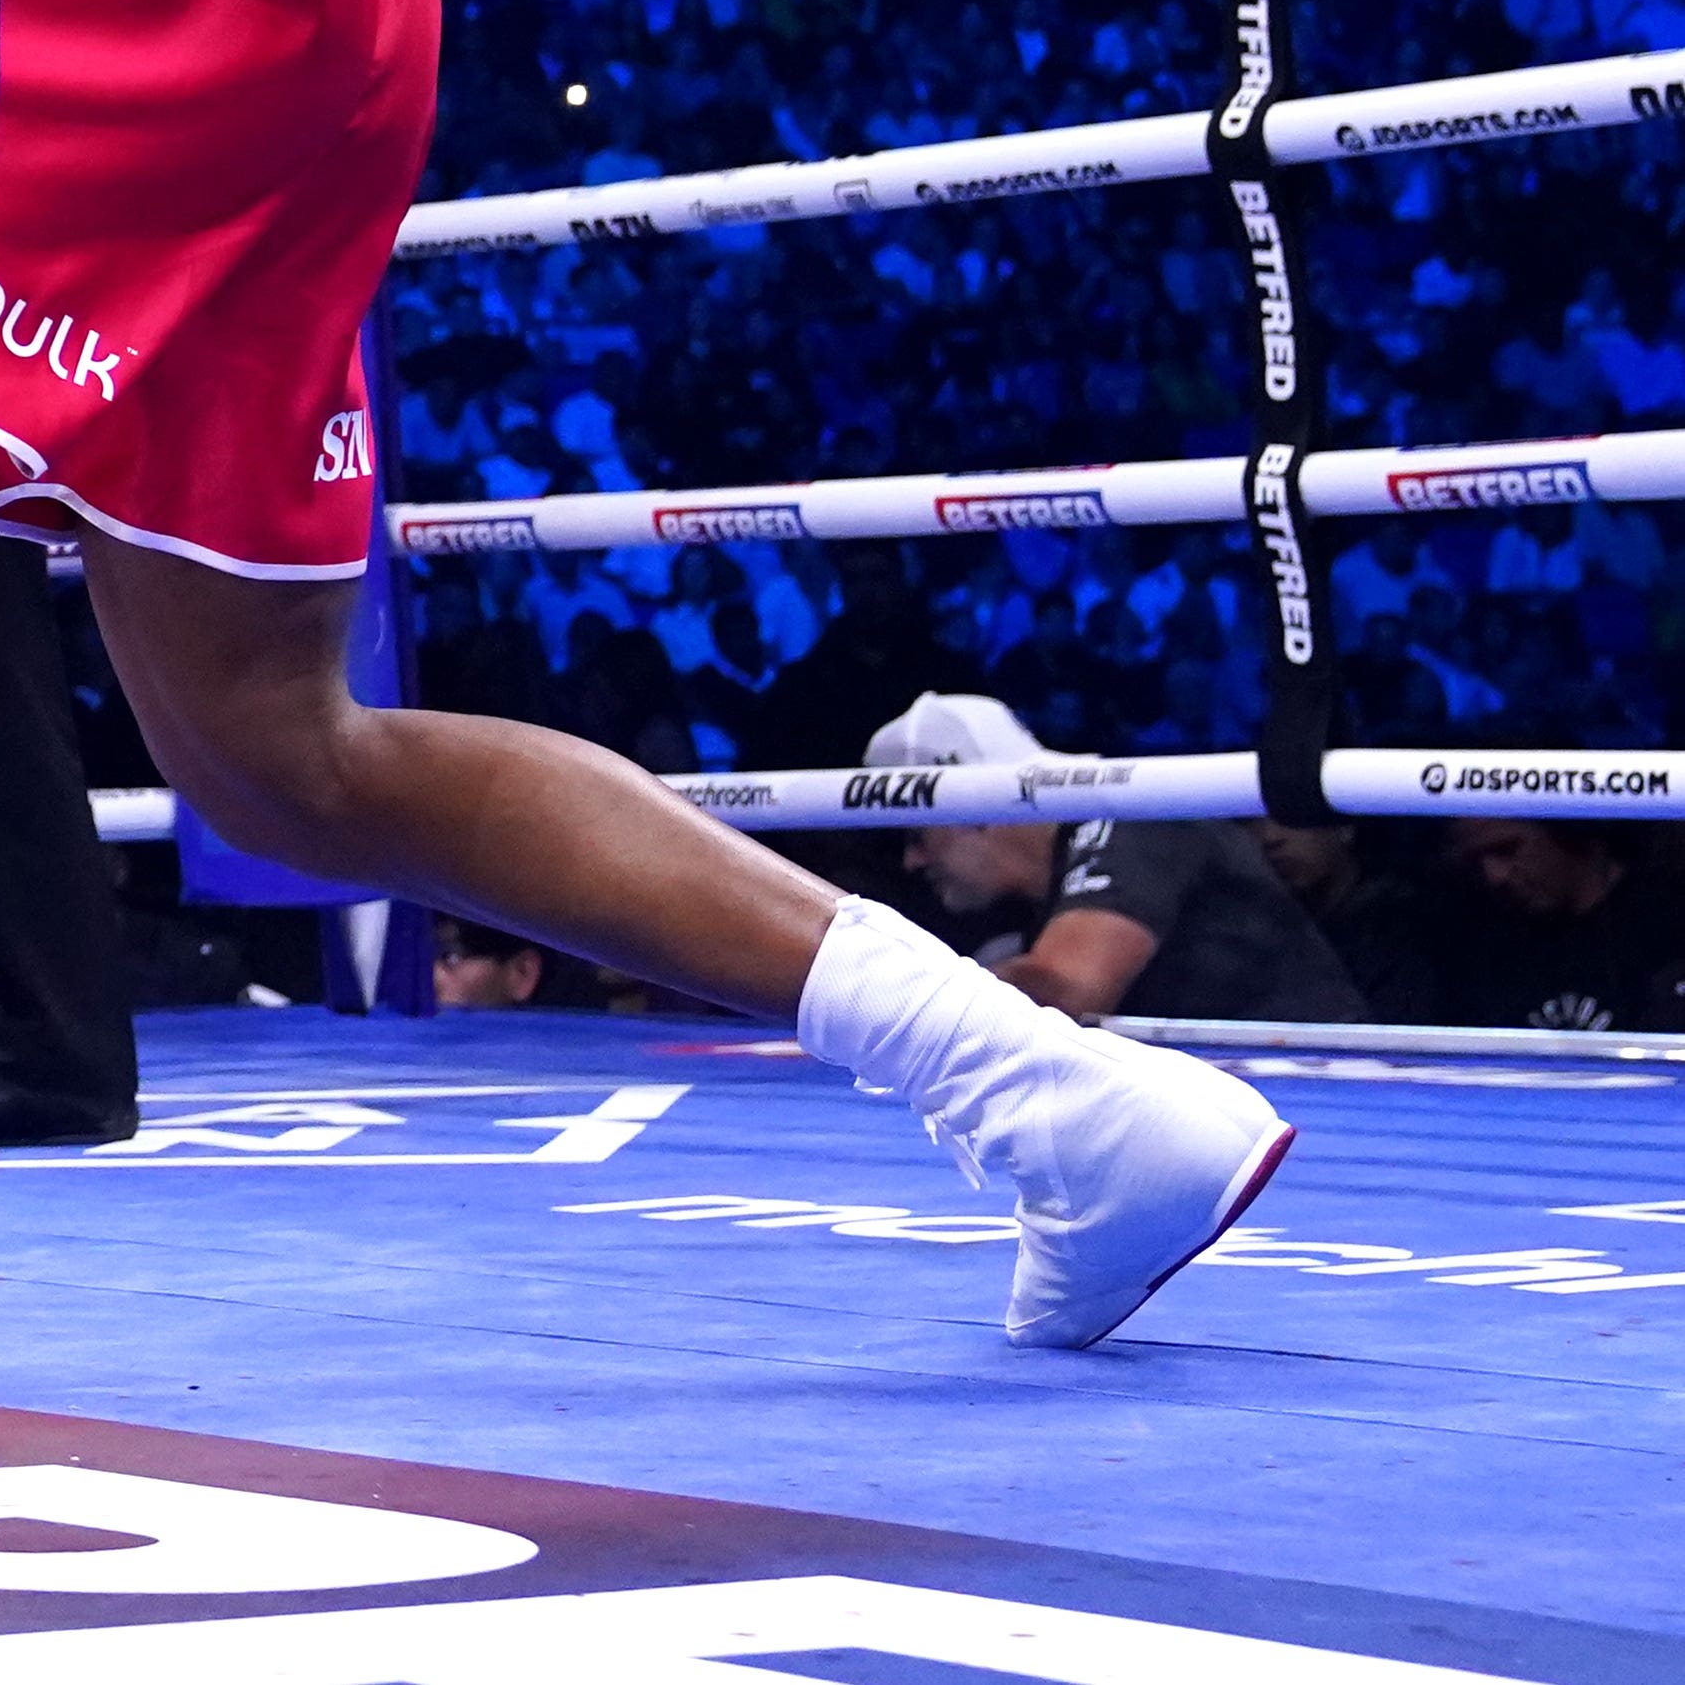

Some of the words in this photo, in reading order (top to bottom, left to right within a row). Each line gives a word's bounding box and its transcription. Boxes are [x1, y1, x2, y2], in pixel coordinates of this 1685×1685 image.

[1371, 101, 1581, 147] JDSPORTS.COM
[1231, 180, 1296, 402] BETFRED
[1394, 467, 1590, 510] BETFRED
[1251, 444, 1314, 665] BETFRED
[842, 772, 940, 810] DAZN
[1454, 768, 1670, 795] JDSPORTS.COM
